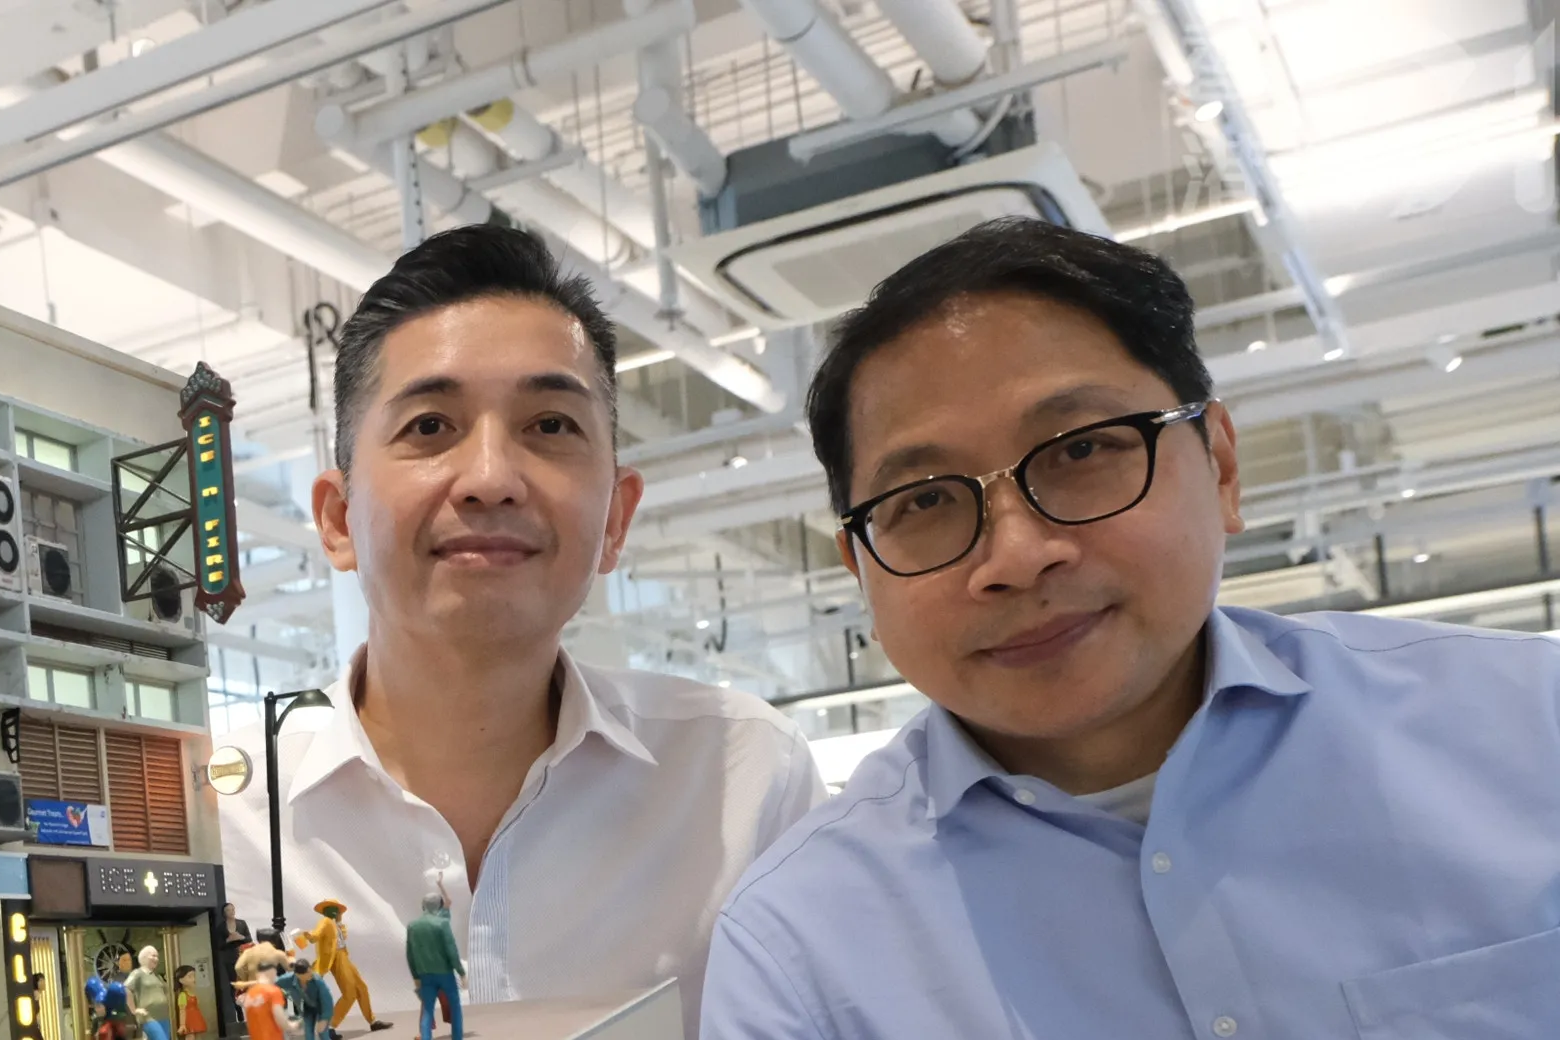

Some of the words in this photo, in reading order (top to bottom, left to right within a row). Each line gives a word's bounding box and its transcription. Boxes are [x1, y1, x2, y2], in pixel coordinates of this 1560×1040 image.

[197, 416, 215, 463] ICE
[204, 518, 224, 583] FIRE
[100, 867, 136, 893] ICE
[163, 871, 208, 897] FIRE
